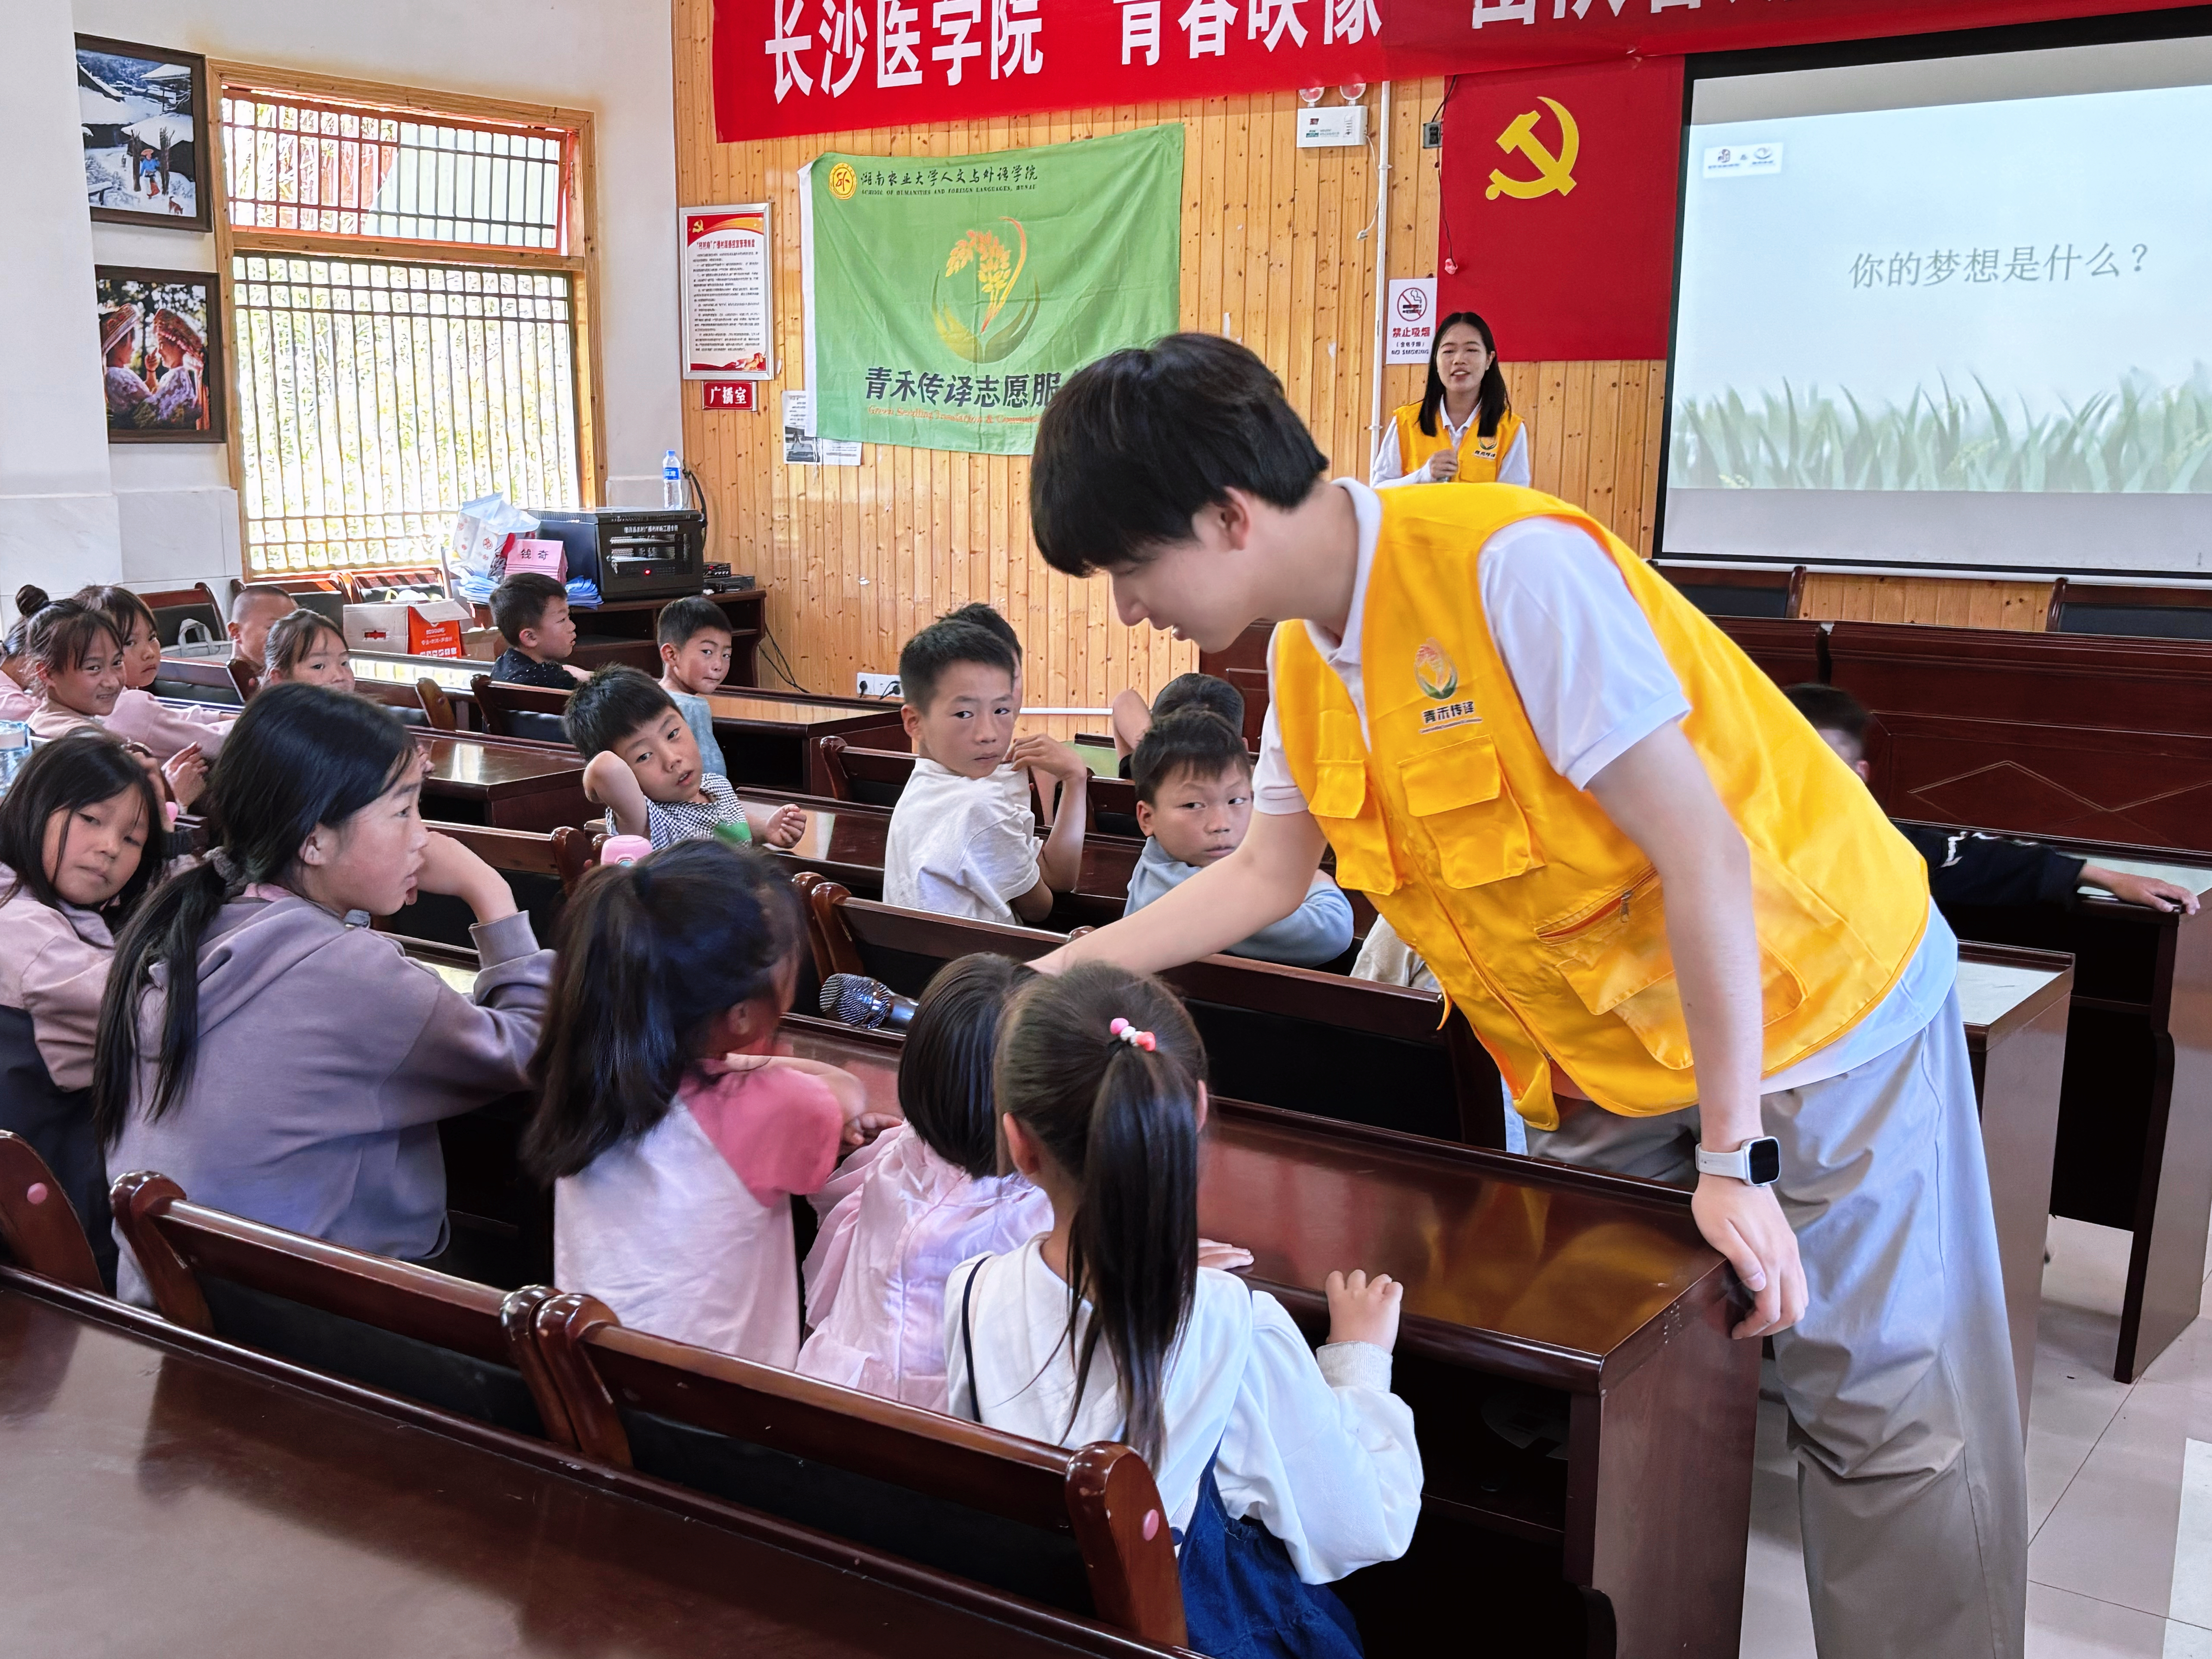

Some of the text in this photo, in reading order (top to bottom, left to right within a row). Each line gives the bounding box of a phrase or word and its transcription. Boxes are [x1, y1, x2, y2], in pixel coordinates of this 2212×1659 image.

[765, 0, 1043, 104] 长沙医学院
[1392, 327, 1430, 338] 禁止吸烟
[710, 386, 747, 404] 广播室
[868, 405, 894, 415] Green
[985, 414, 993, 424] &
[1423, 701, 1474, 724] 青禾传译
